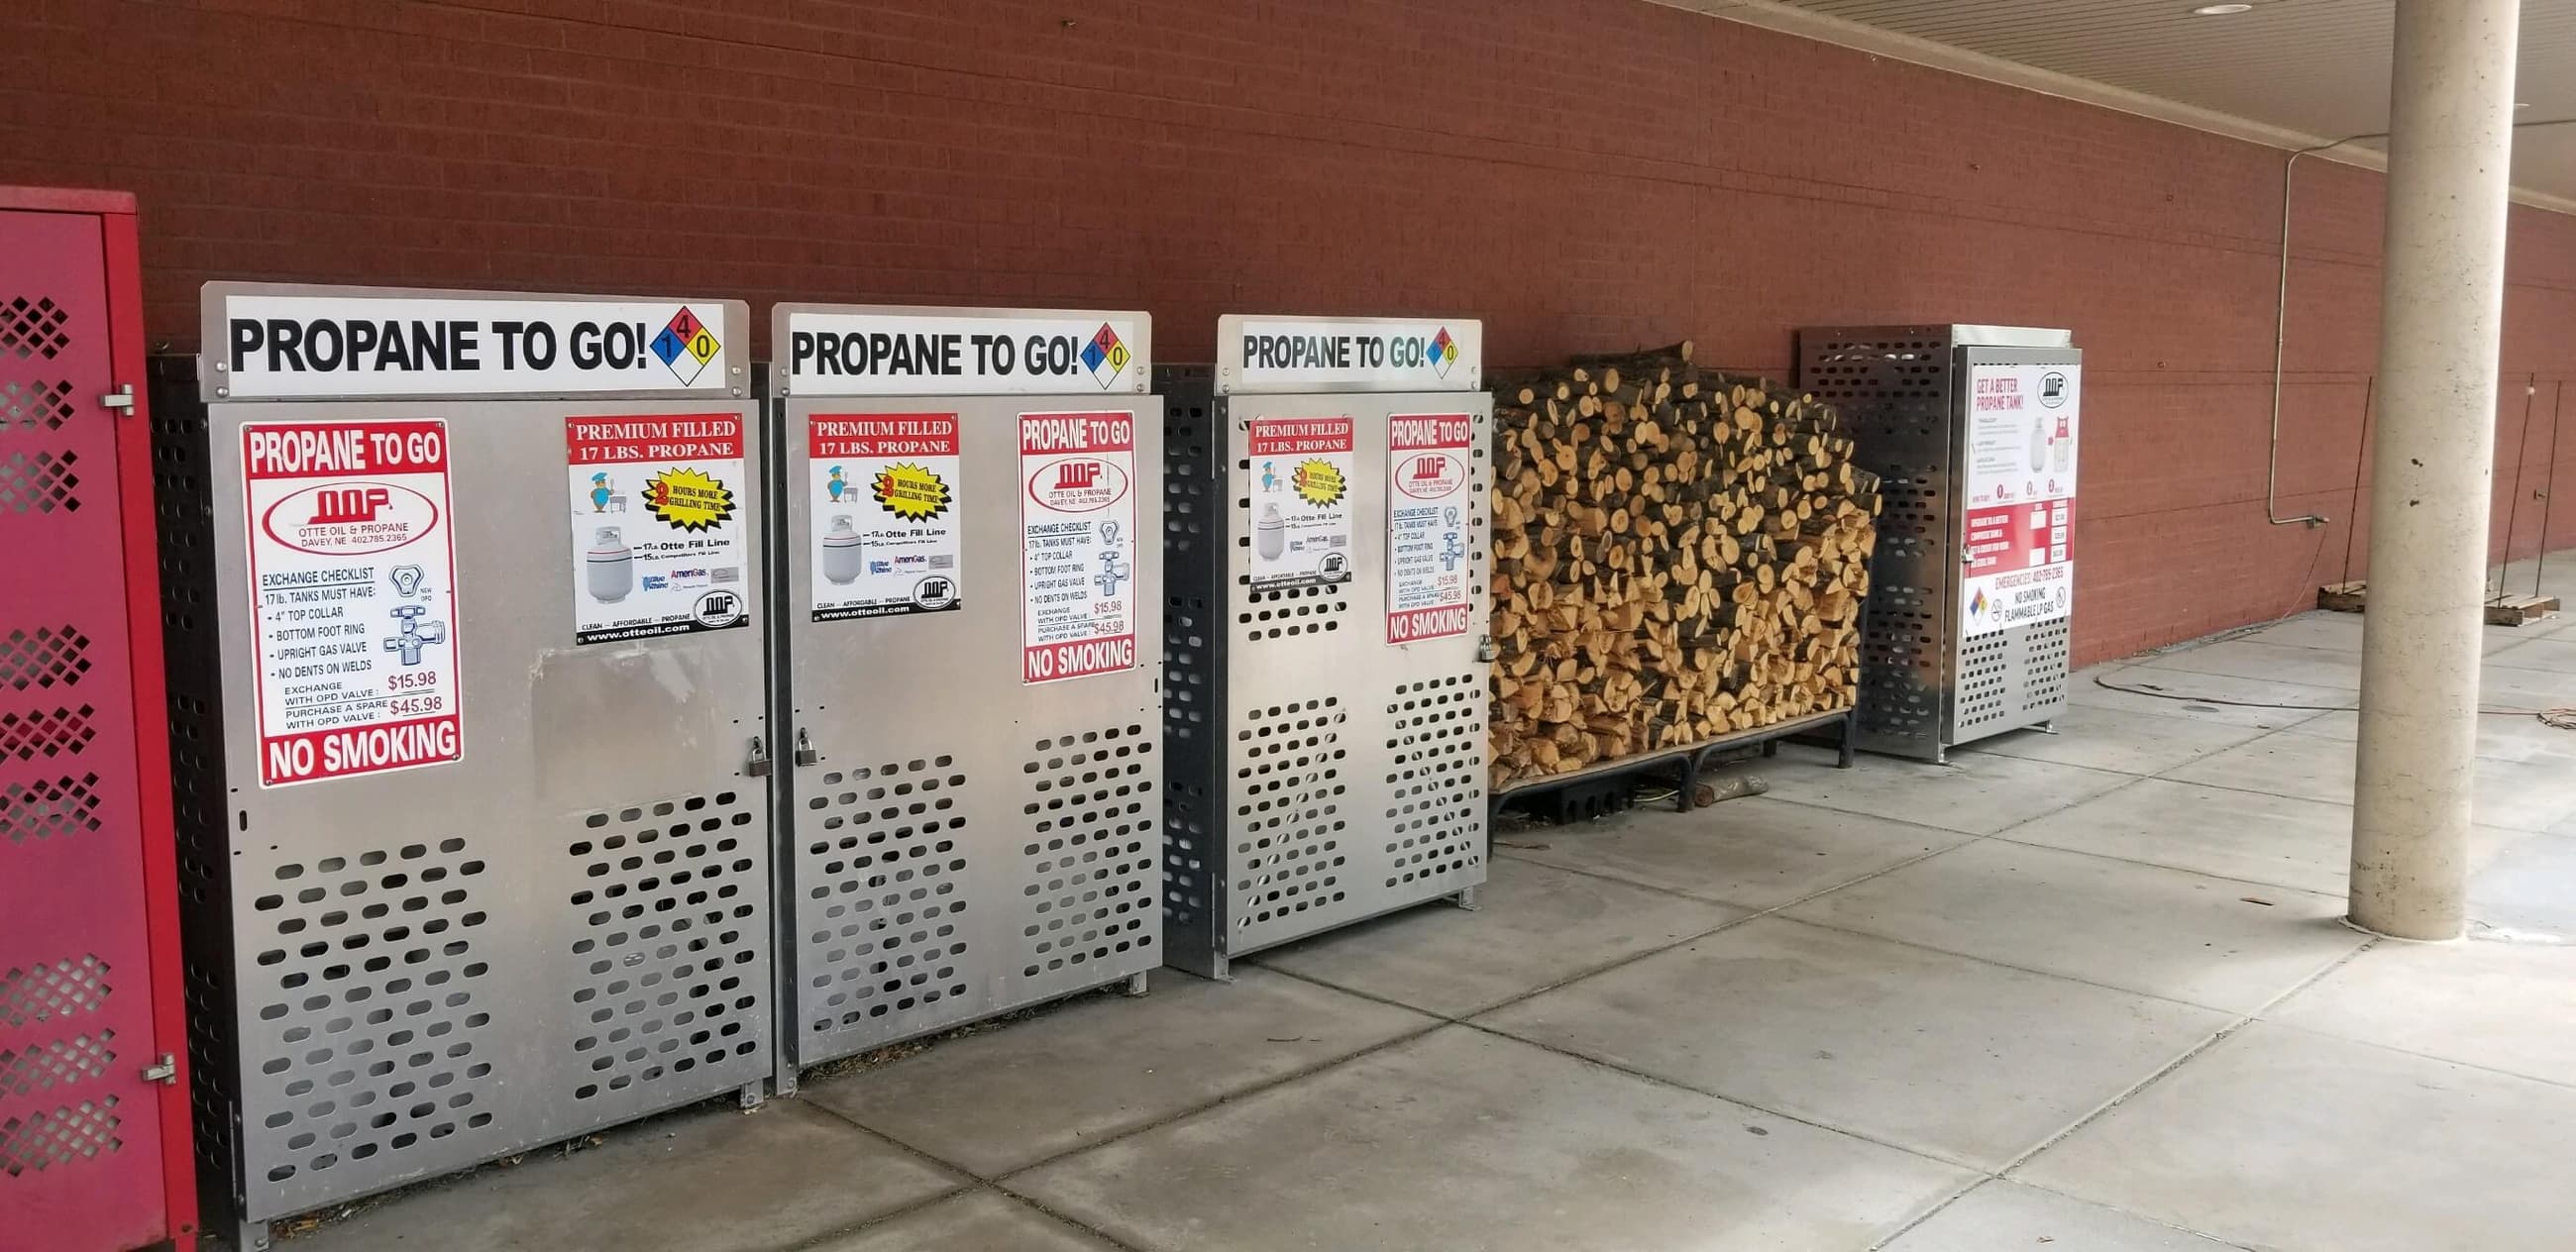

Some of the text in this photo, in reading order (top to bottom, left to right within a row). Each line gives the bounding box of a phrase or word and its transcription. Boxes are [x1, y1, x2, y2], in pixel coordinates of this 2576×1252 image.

[677, 315, 691, 338] 4
[231, 319, 647, 371] PROPANE TO GO!
[662, 334, 709, 358] 1 0
[1100, 331, 1111, 349] 4
[793, 331, 1079, 375] PROPANE TO GO!
[1114, 348, 1123, 364] 0
[1243, 336, 1426, 368] PROPANE TO GO!
[1448, 345, 1453, 360] 0
[1978, 378, 2017, 393] GET A BETTER
[1977, 396, 2004, 410] PROPANE
[577, 420, 735, 441] PREMIUM FILLED
[817, 421, 952, 436] PREMIUM FILLED
[1022, 418, 1129, 450] PROPANE TO GO
[1255, 423, 1348, 437] PREMIUM FILLED
[1392, 419, 1467, 447] PROPANE TO GO
[250, 430, 440, 473] PROPANE TO GO
[580, 443, 733, 460] 17 LBS. PROPANE
[820, 441, 950, 455] 17 LBS. PROPANE
[1257, 440, 1346, 453] 17 LBS. PROPANE
[673, 484, 717, 499] HOURS MORE
[898, 478, 917, 489] HOURS
[894, 489, 938, 503] GRILLING TIME
[670, 498, 721, 511] GRILLING TIME
[299, 523, 409, 537] OTTE OIL & PROPANE
[1028, 521, 1091, 534] EXCHANGE CHECKLIST
[301, 536, 332, 548] DAVEY,
[335, 536, 346, 545] NE
[661, 542, 687, 551] Otte
[706, 539, 730, 548] Line
[263, 567, 375, 586] EXCHANGE CHECKLIST
[671, 568, 706, 578] AmeriGas
[290, 590, 319, 603] TANKS
[322, 588, 347, 600] MUST
[350, 586, 376, 598] HAVE:
[2015, 587, 2046, 603] NO SMOKING
[288, 609, 306, 621] TOP
[309, 607, 343, 619] COLLAR
[821, 606, 910, 619] www.otteoil.com
[1094, 600, 1122, 615] $15.98
[2005, 601, 2054, 622] FLAMMABLE LP GAS
[276, 623, 365, 641] BOTTOM FOOT RING
[582, 622, 602, 631] CLEAN
[612, 618, 652, 627] AFFORDABLE
[1094, 621, 1125, 635] $45.98
[1391, 608, 1465, 640] NO SMOKING
[588, 624, 690, 642] www.otteoil.com
[277, 642, 367, 660] UPRIGHT GAS VALVE
[1028, 638, 1132, 678] NO SMOKING
[278, 660, 372, 678] NO DENTS ON WELDS
[284, 682, 342, 694] EXCHANGE
[388, 671, 436, 691] $15.98
[285, 694, 312, 705] WITH
[317, 692, 339, 703] OPD
[390, 696, 442, 716] $45.98
[286, 706, 342, 718] PURCHASE
[356, 699, 387, 709] SPARE
[286, 718, 314, 729] WITH
[318, 716, 339, 726] OPD
[269, 720, 456, 780] NO SMOKING
